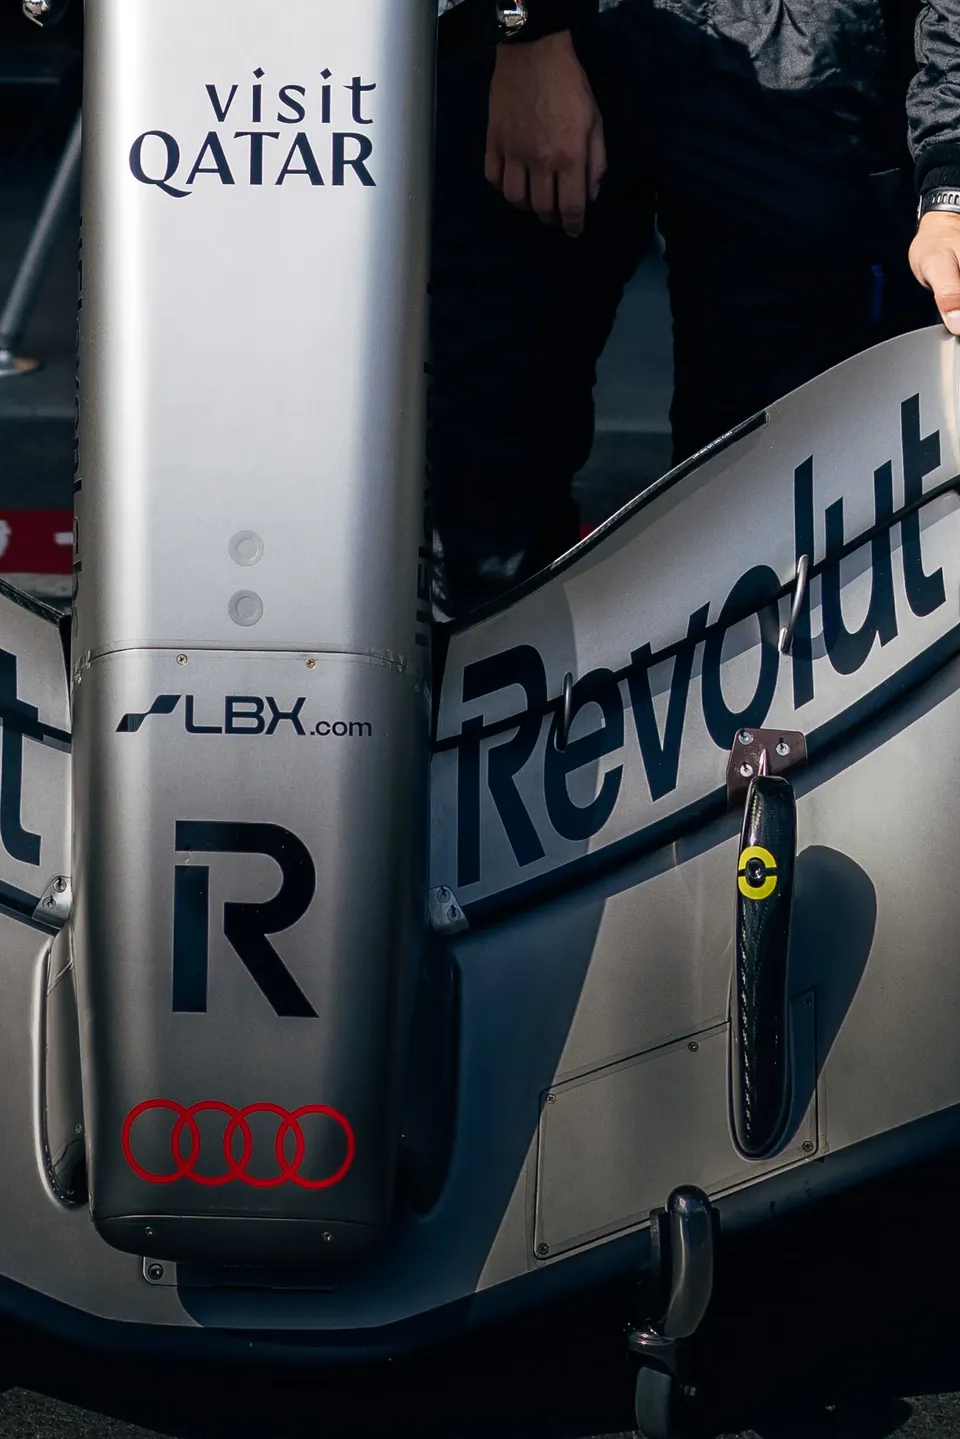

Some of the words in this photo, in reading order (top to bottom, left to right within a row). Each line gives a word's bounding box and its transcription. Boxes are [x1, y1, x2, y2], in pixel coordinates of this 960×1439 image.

[204, 67, 377, 124] visit
[129, 129, 377, 198] QATAR
[456, 392, 946, 888] Revolut
[171, 820, 320, 1018] R
